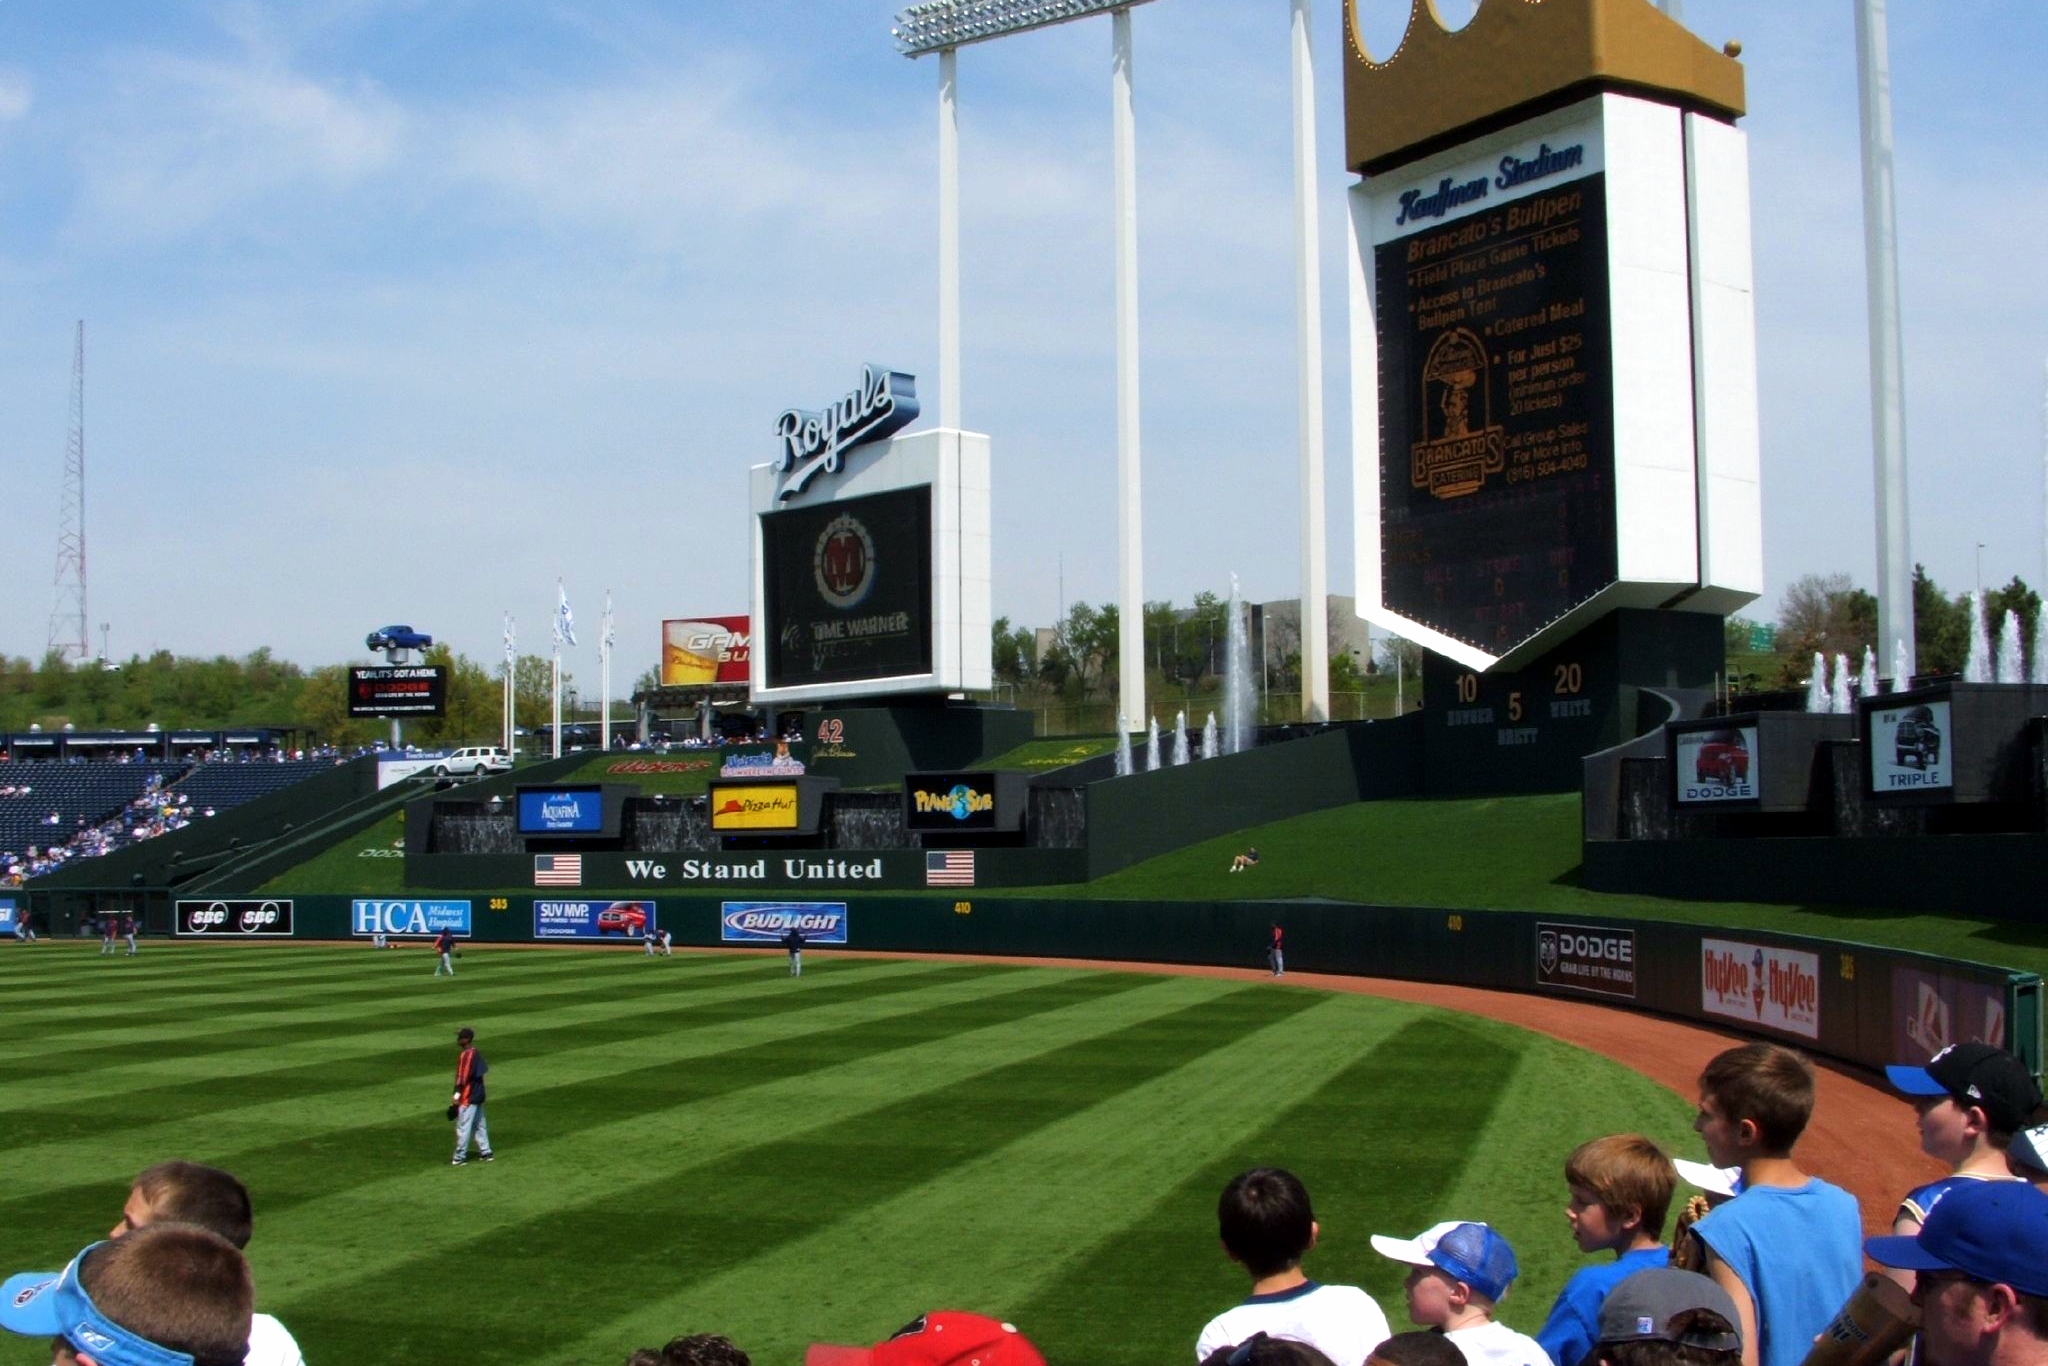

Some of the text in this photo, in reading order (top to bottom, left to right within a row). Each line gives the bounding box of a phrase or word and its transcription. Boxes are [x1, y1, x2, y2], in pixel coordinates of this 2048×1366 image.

[1396, 143, 1583, 225] Kauffman Stadium
[1408, 191, 1582, 263] Brancato's Bullpen
[1417, 226, 1580, 287] Field Plaza Game Tickets
[1418, 262, 1548, 312] Access to Brancato's
[1419, 297, 1497, 331] Bullpen Tent
[1494, 296, 1584, 336] Catered Meal
[1507, 333, 1583, 364] For Just $25
[1508, 356, 1575, 386] per person
[773, 362, 902, 482] Royals
[1514, 449, 1532, 464] For
[1534, 443, 1560, 459] More
[846, 611, 910, 636] WARNER
[687, 632, 750, 650] GAM
[718, 650, 750, 663] BU
[1456, 673, 1478, 703] 10
[1554, 663, 1583, 695] 20
[1508, 691, 1523, 721] 5
[1550, 699, 1591, 718] WHITE
[817, 719, 844, 744] 42
[1497, 728, 1538, 746] BRETT
[1888, 772, 1939, 787] TRIPLE
[965, 789, 993, 813] SUB
[1686, 785, 1751, 799] DODGE
[541, 801, 581, 821] AQUAFINA
[743, 797, 797, 812] Pizza Hut
[625, 859, 883, 879] We Stand United
[490, 898, 508, 910] 385
[540, 903, 563, 917] SUV
[954, 902, 971, 915] 410
[192, 911, 225, 924] SBC
[243, 911, 276, 924] SBC
[356, 902, 430, 933] HCA
[743, 913, 841, 931] BUD LIGHT
[1559, 934, 1632, 962] DODGE
[1560, 961, 1577, 975] GRAB
[1578, 963, 1590, 976] LIFE
